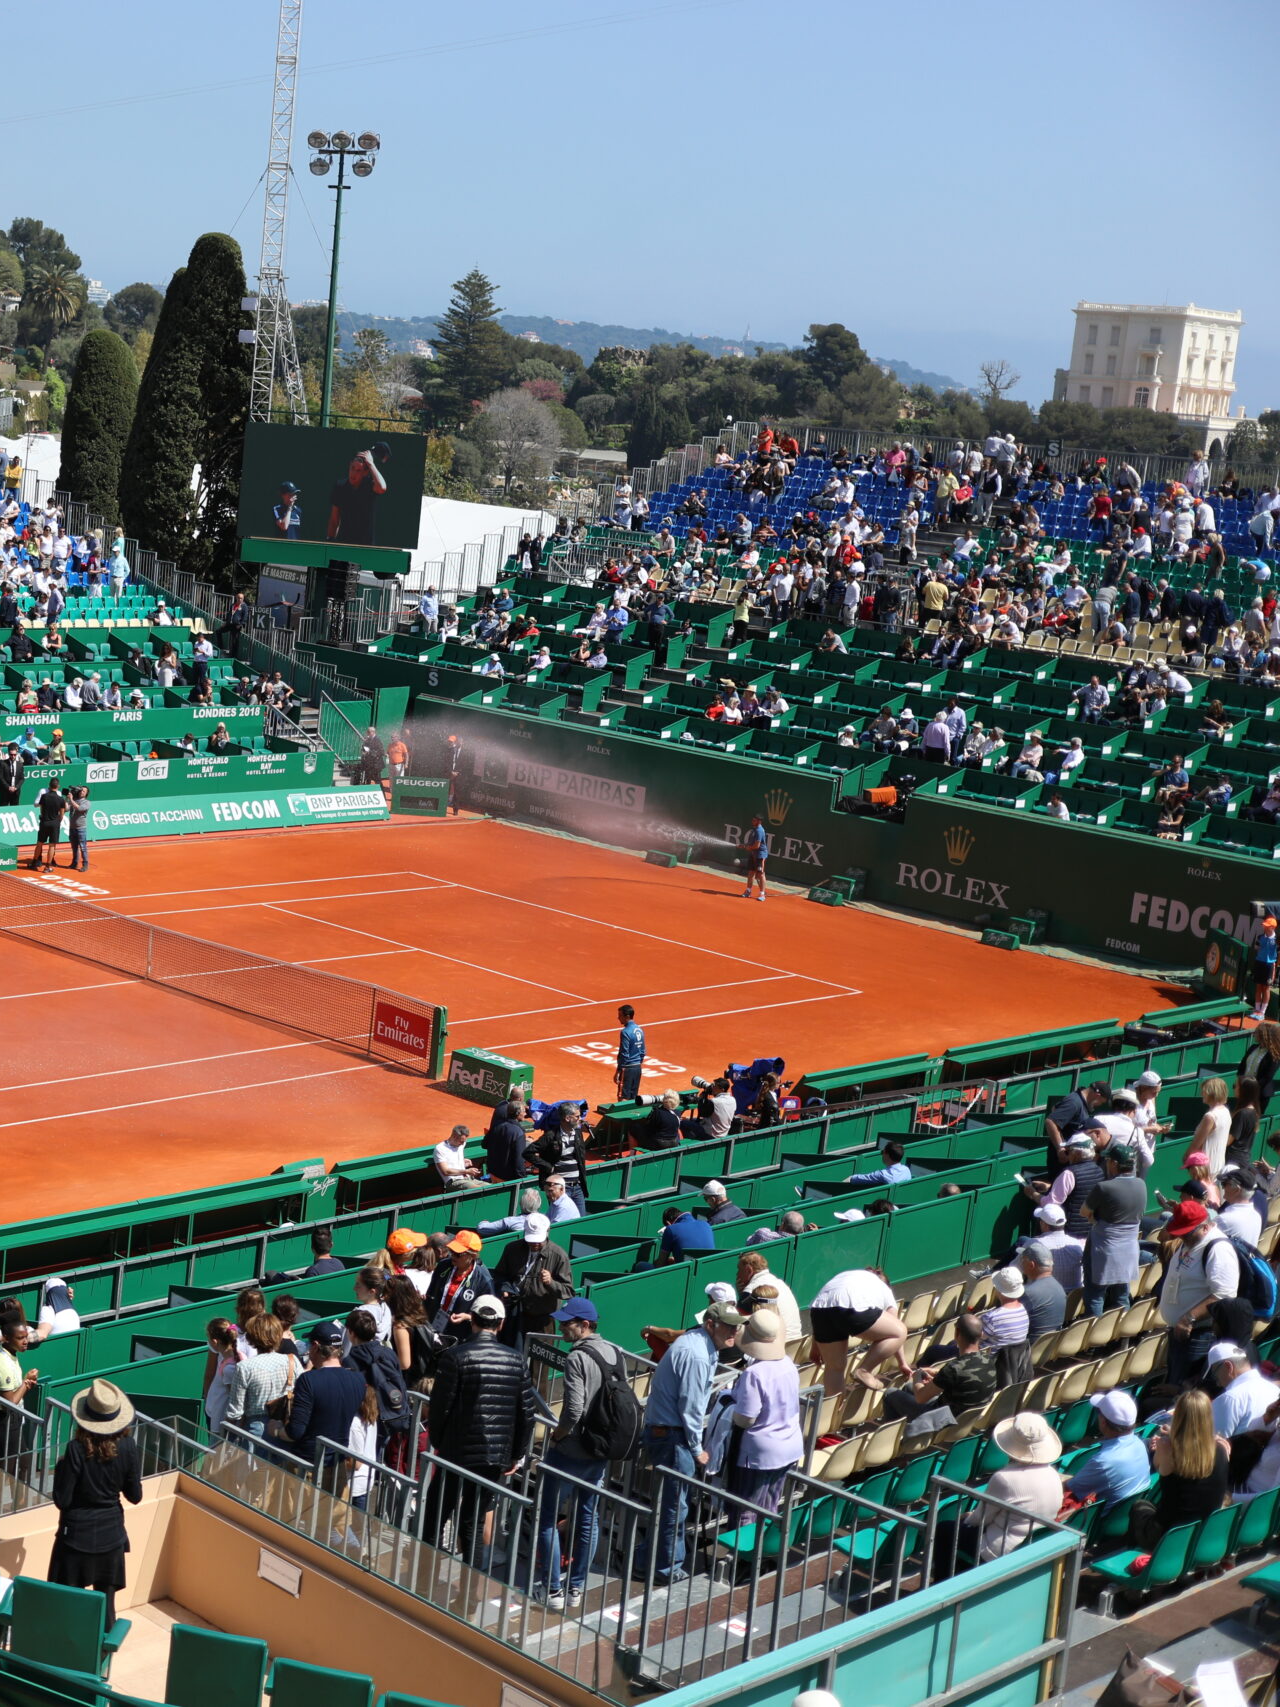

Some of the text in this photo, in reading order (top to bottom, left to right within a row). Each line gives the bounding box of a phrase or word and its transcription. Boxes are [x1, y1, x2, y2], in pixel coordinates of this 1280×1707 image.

[1048, 443, 1059, 457] S
[262, 567, 270, 576] LE
[270, 568, 295, 581] MASTERS
[256, 614, 266, 629] K
[428, 671, 439, 687] S
[5, 714, 60, 727] SHANGHAI
[113, 711, 143, 722] PARIS
[193, 706, 261, 719] LONDRES 2018
[586, 744, 611, 756] ROLEX
[24, 768, 67, 779] UGEOT
[395, 778, 447, 788] PEUGEOT
[514, 762, 637, 807] BNP PARIBAS
[310, 793, 381, 810] BNP PARIBAS
[110, 808, 204, 826] SERGIO TACCHINI
[211, 800, 281, 823] FEDCOM
[1187, 867, 1222, 881] ROLEX
[895, 862, 1010, 910] ROLEX
[1105, 937, 1141, 954] FEDCOM
[394, 1015, 409, 1031] Fly
[377, 1020, 425, 1050] Emirates
[449, 1060, 507, 1098] FedEx
[532, 1344, 557, 1362] SORTIE
